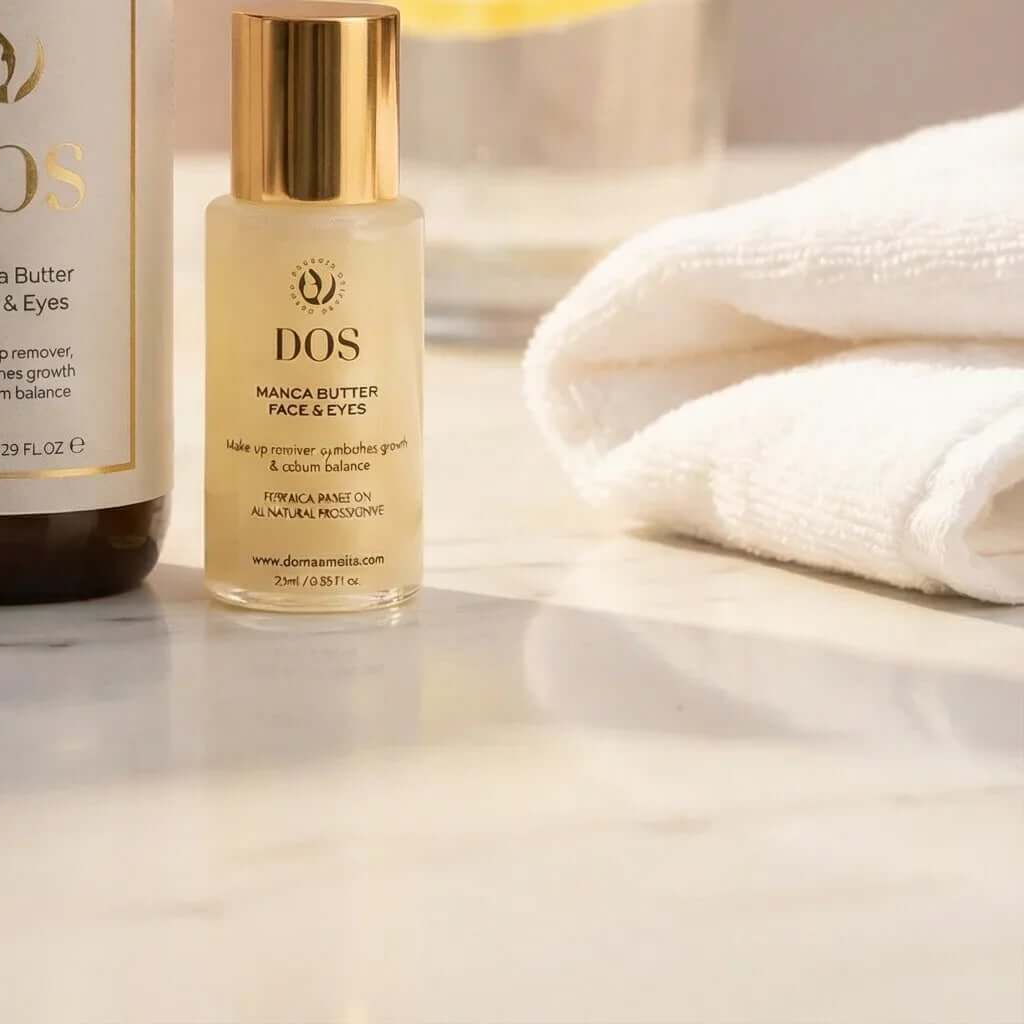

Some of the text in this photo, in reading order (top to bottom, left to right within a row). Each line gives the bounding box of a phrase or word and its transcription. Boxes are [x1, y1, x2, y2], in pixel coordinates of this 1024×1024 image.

[15, 267, 74, 284] Butter
[3, 295, 18, 311] &
[24, 294, 69, 316] Eyes
[277, 328, 359, 362] DOS
[12, 346, 72, 360] remover,
[26, 364, 75, 383] growth
[16, 385, 71, 399] balance
[257, 386, 378, 400] MANCA BUTTER
[269, 403, 366, 416] FACE & EYES
[269, 460, 279, 471] &
[325, 460, 370, 472] balance
[267, 507, 315, 519] NATURAL
